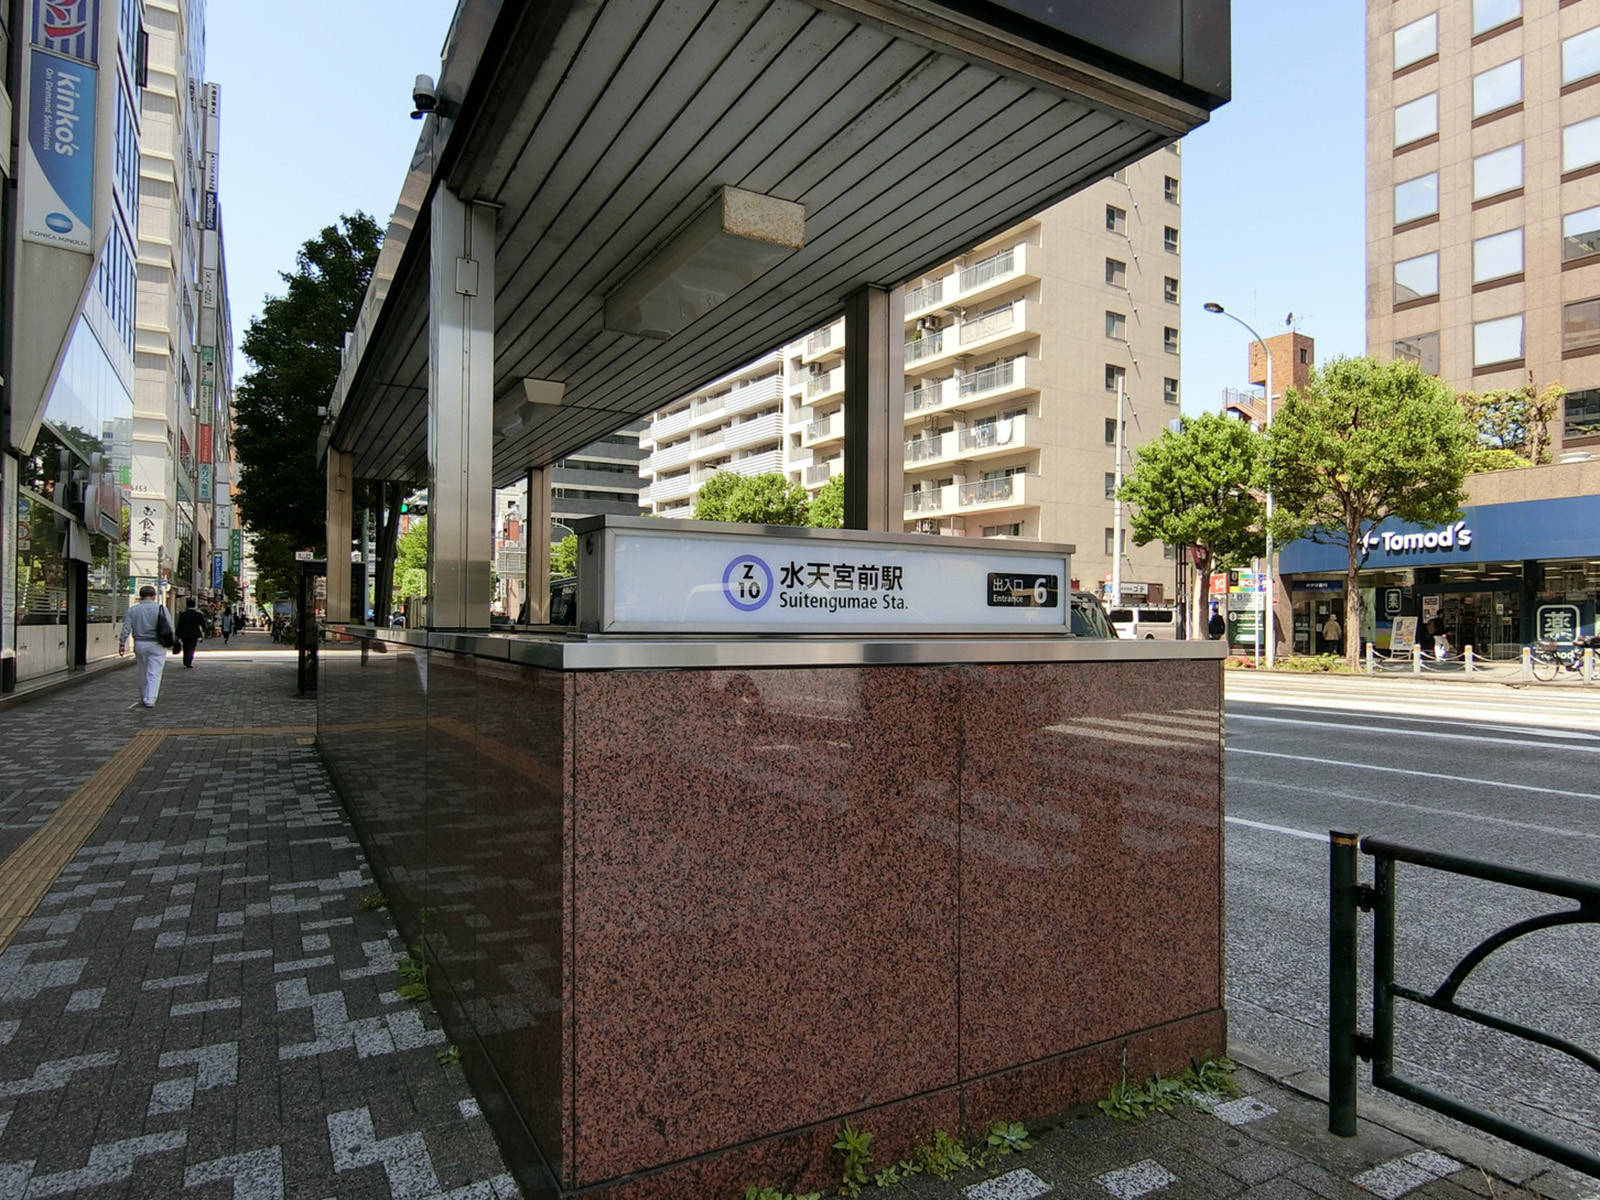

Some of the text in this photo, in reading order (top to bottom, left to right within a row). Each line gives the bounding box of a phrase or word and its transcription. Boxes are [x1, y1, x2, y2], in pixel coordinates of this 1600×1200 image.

[43, 68, 54, 151] On Demand Solutions
[55, 71, 81, 157] kinko's
[29, 230, 88, 247] KONICA MINOLTA
[139, 505, 156, 546] お食事
[1381, 521, 1473, 551] Tomod's
[743, 564, 754, 579] Z
[780, 561, 904, 591] 水天宮前駅
[738, 582, 761, 599] 10
[993, 578, 1024, 592] 出入口
[1034, 578, 1047, 604] 6
[780, 592, 909, 612] Suitengumae Sta.
[993, 594, 1024, 604] Entrance
[1388, 592, 1399, 609] 薬
[1544, 611, 1573, 641] 薬
